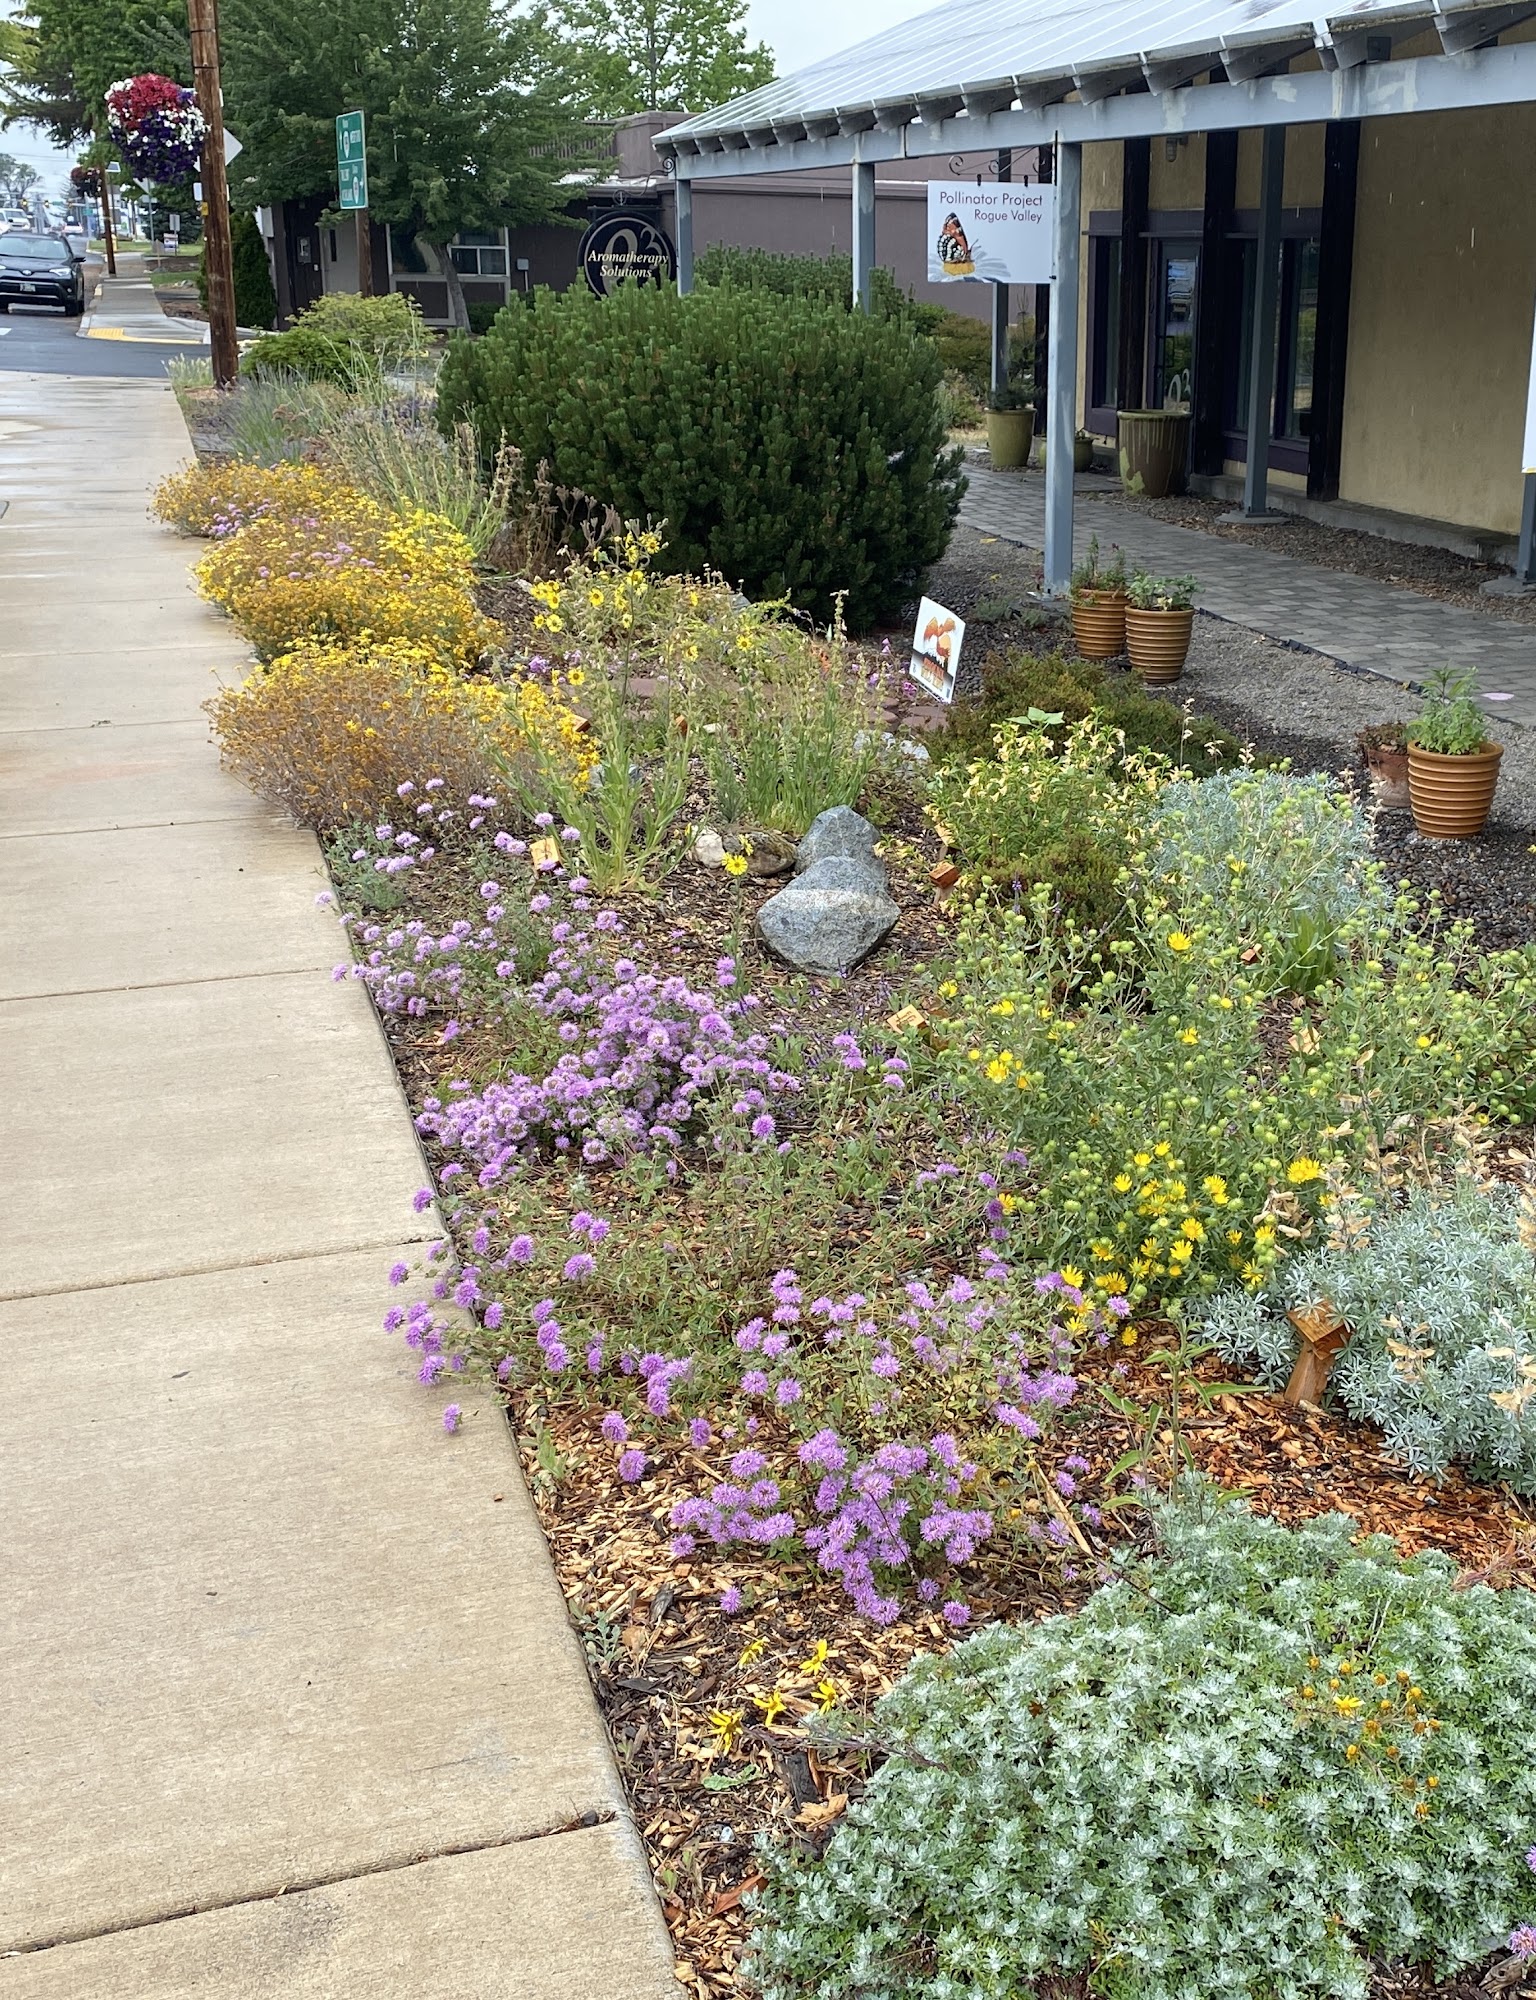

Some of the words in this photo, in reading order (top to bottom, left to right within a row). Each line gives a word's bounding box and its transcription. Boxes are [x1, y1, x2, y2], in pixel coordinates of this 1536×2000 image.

[940, 191, 998, 205] Pollinator
[1002, 193, 1043, 208] Project
[974, 209, 1008, 223] Rogue
[1011, 210, 1042, 224] Valley
[587, 250, 669, 266] Aromatherapy
[600, 264, 652, 277] Solutions
